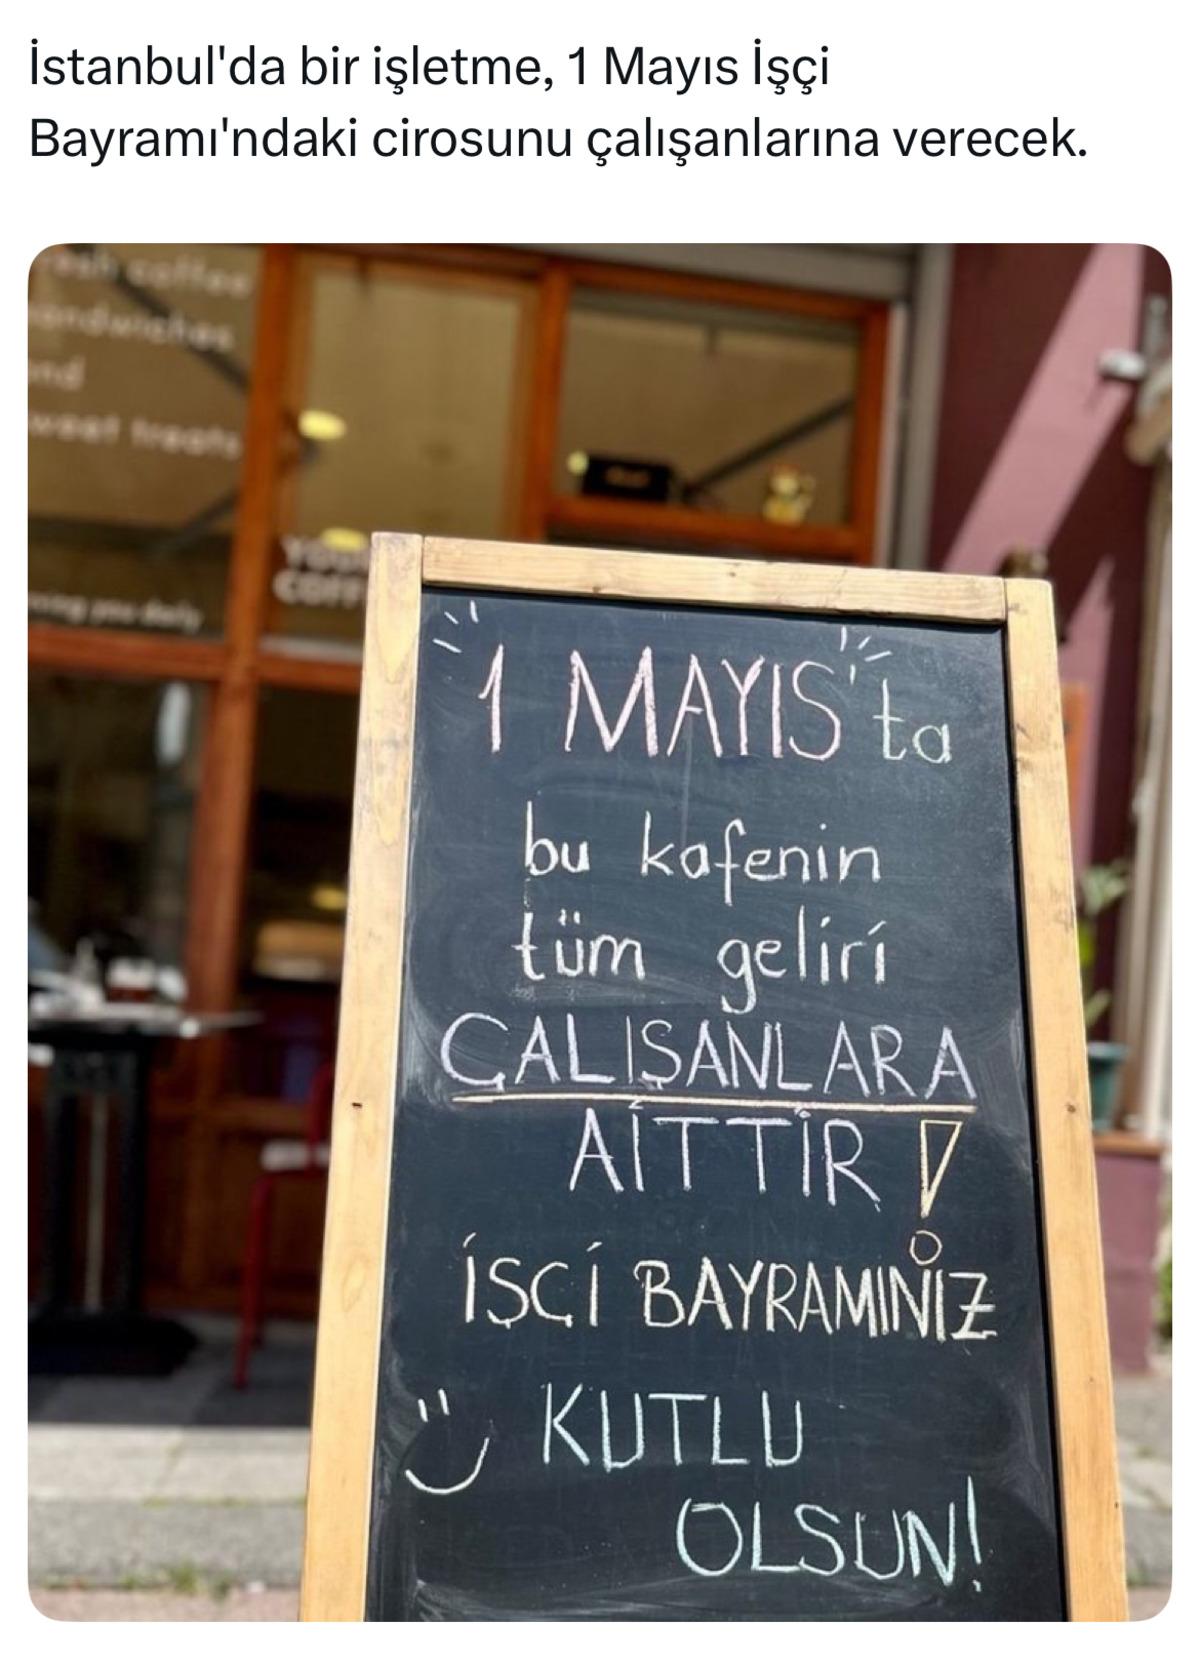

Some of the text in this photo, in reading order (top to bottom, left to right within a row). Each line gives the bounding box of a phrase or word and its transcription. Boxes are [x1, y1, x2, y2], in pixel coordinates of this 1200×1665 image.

[28, 411, 121, 445] weet
[478, 644, 503, 754] 1
[524, 800, 881, 905] bu kafenin
[511, 904, 887, 1014] tüm geliri
[542, 1382, 803, 1473] KUTLU
[676, 1475, 983, 1592] OLSUN!
